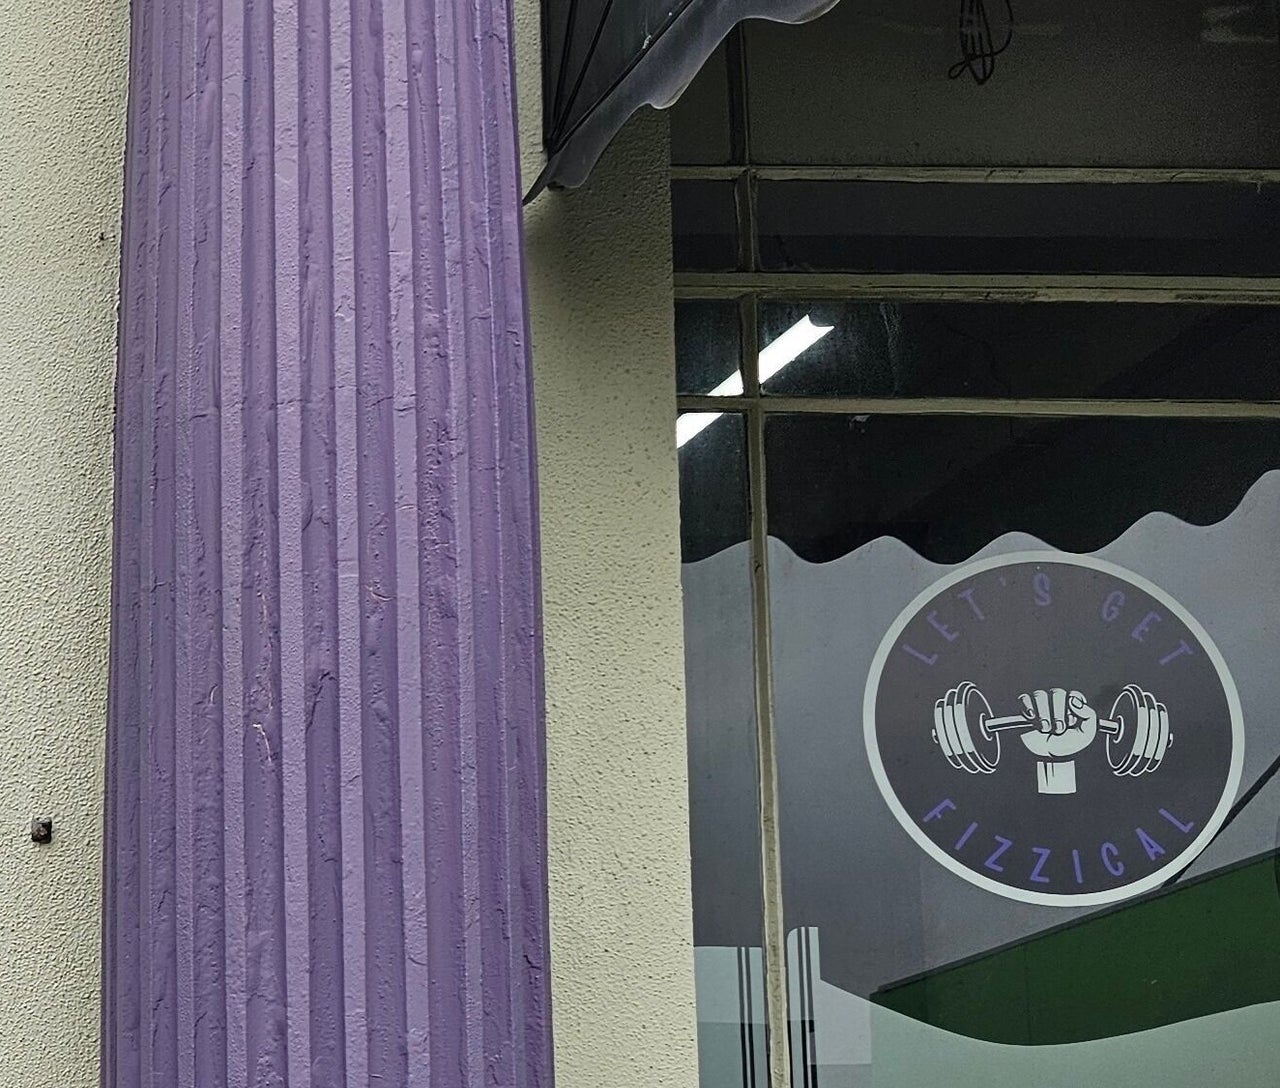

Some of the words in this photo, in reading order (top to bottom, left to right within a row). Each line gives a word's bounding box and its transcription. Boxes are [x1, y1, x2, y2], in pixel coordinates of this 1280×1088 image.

[902, 573, 1051, 665] LET'S
[1102, 591, 1194, 666] GET
[923, 799, 1195, 884] FIZZICAL
